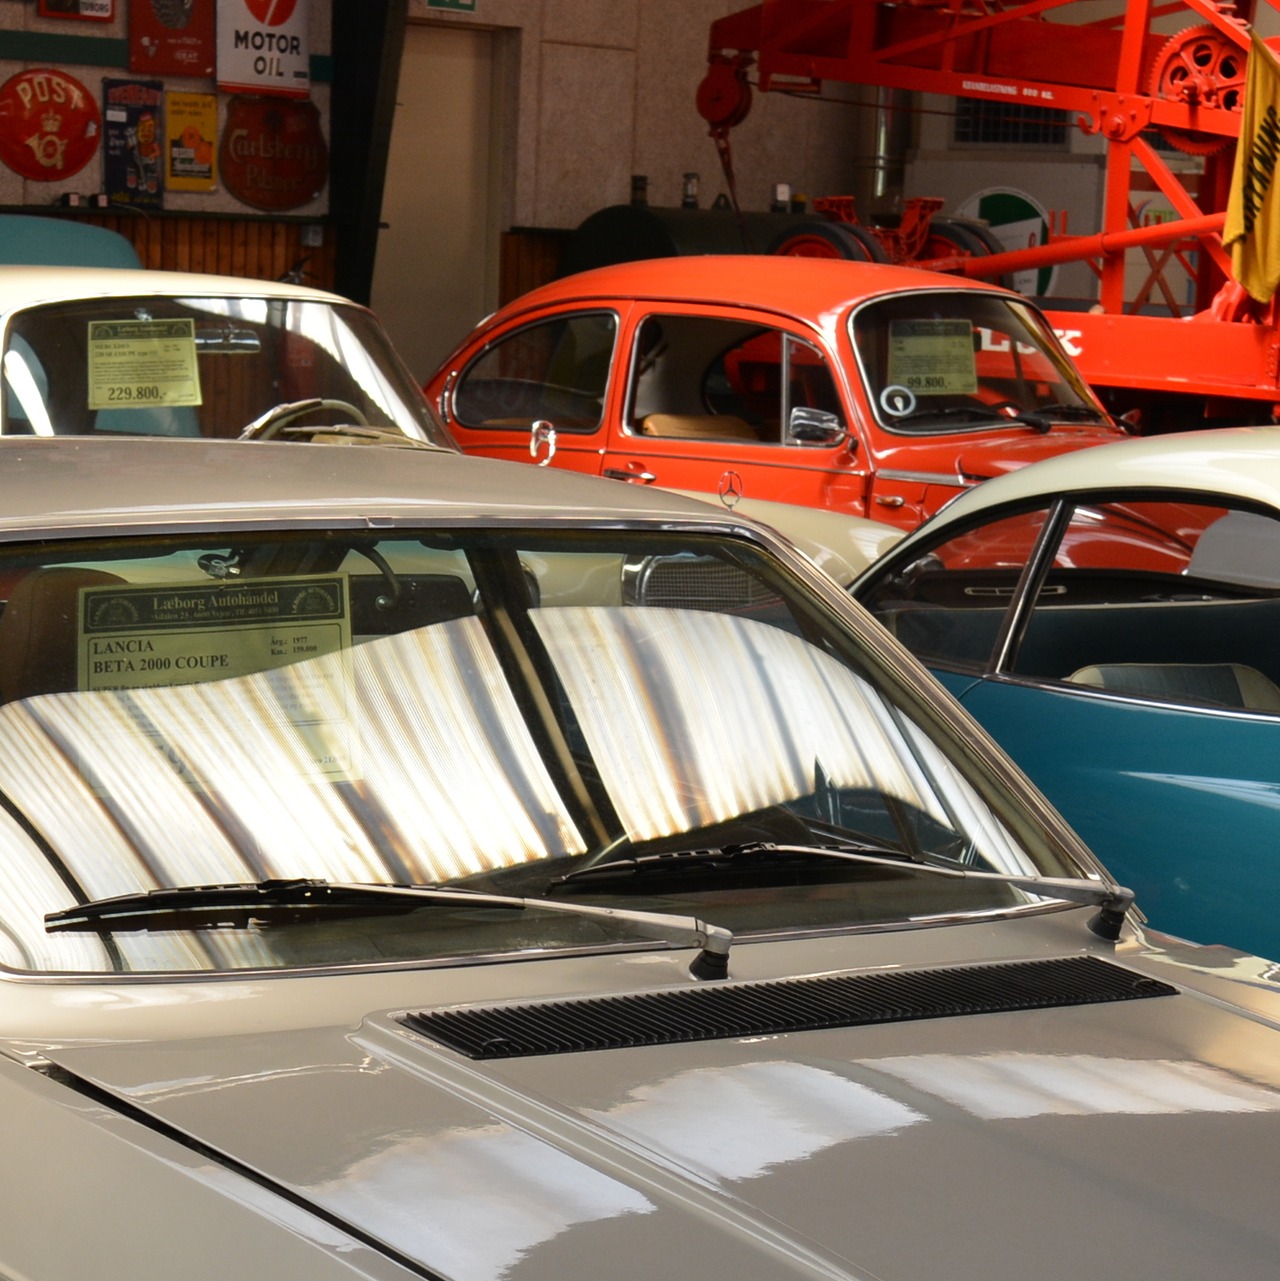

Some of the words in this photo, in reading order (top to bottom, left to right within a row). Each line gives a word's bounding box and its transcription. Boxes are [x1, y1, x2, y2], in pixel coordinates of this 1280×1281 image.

[234, 30, 300, 55] MOTOR
[254, 56, 284, 77] OIL
[16, 76, 84, 110] POST
[230, 128, 318, 170] Carlsberg
[153, 596, 206, 611] Læborg
[210, 591, 279, 606] Autohandel
[93, 639, 154, 656] LANCIA
[292, 636, 308, 644] 1977
[93, 659, 135, 674] BETA
[139, 657, 171, 672] 2000
[174, 654, 229, 670] COUPE
